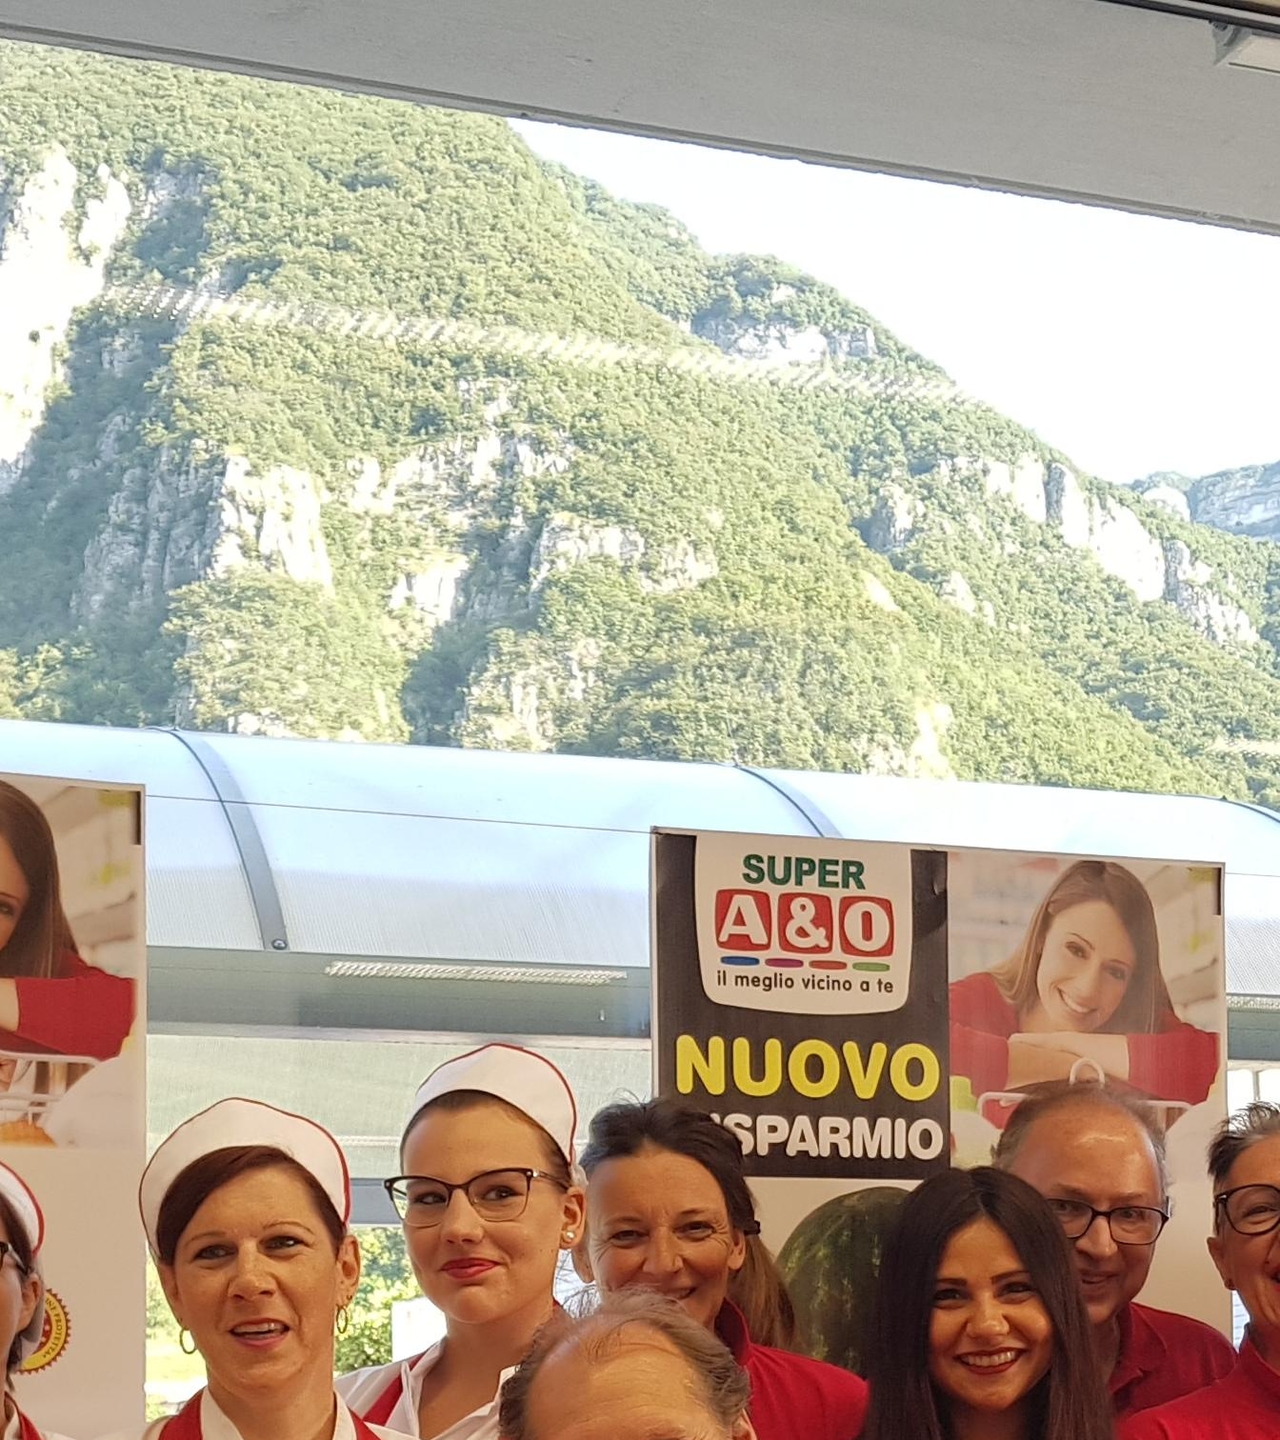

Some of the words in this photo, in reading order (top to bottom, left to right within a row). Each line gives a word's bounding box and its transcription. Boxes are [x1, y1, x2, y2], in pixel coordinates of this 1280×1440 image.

[742, 854, 866, 890] SUPER
[718, 893, 890, 952] A&O
[716, 970, 727, 986] il
[734, 972, 795, 992] meglio
[802, 974, 853, 991] vicino
[860, 980, 871, 992] a
[877, 978, 894, 993] te
[675, 1034, 941, 1101] NUOVO
[710, 1113, 944, 1160] SPARMIO
